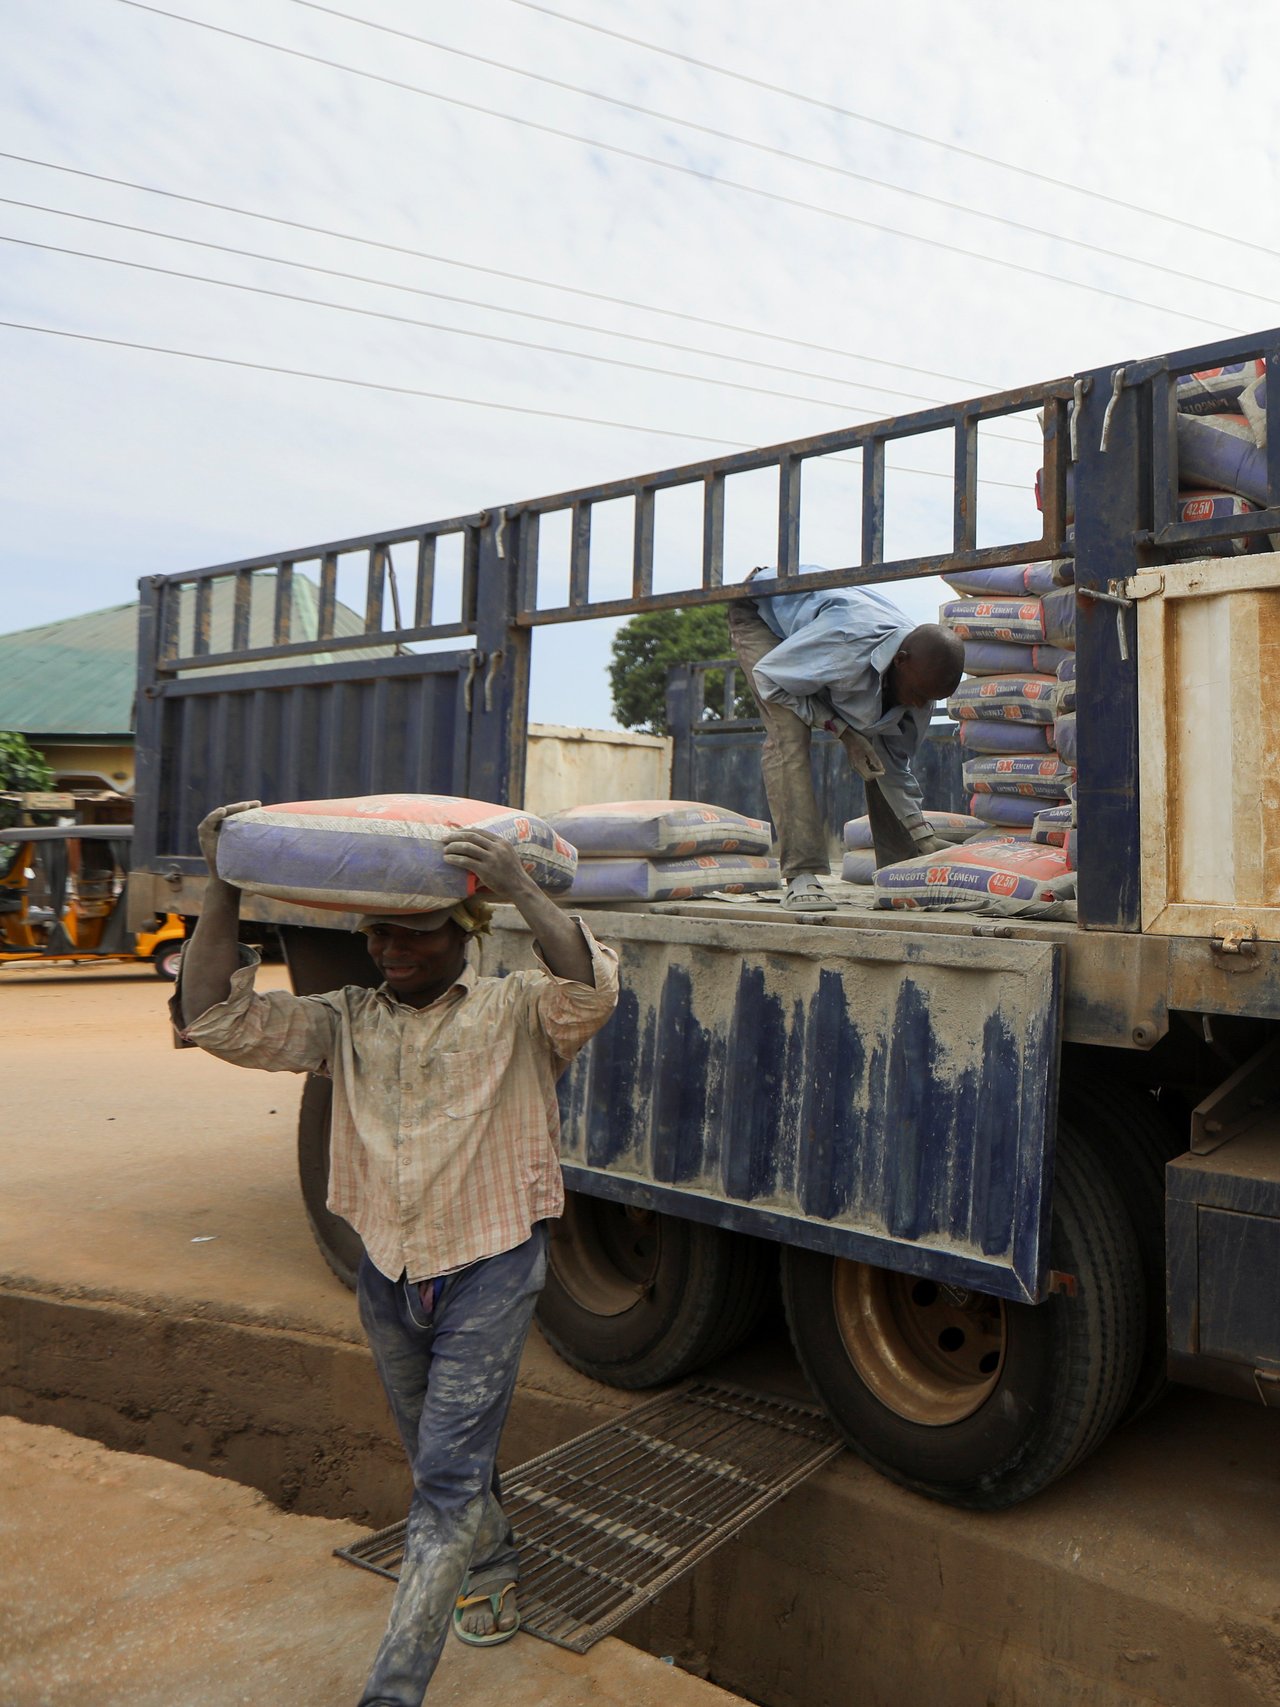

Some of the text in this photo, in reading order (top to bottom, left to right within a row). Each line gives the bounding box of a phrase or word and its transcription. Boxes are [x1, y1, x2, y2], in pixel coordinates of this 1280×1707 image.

[1186, 501, 1210, 516] 42.5N
[889, 867, 1017, 888] DANGOTE 3X CEMENT 42.5N
